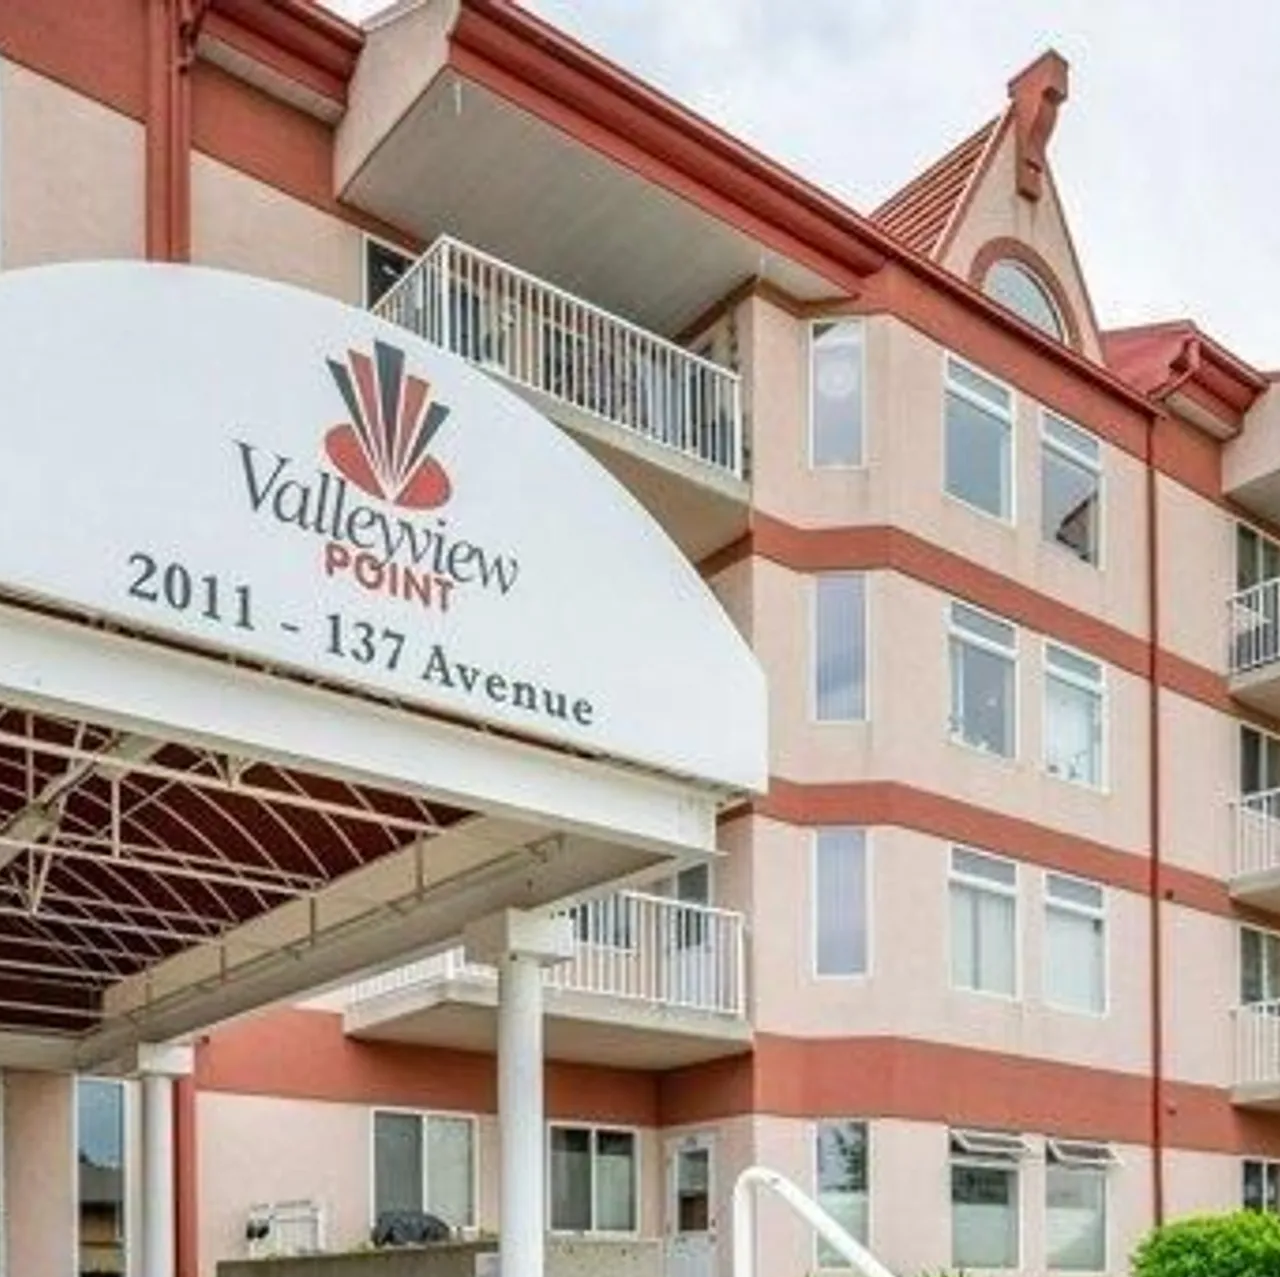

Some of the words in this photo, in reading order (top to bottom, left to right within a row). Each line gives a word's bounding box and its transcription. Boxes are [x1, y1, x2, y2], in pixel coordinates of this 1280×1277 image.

[233, 438, 520, 595] Valleyview
[324, 542, 454, 613] POINT
[127, 552, 256, 632] 2011
[325, 613, 406, 671] 137
[421, 644, 594, 726] Avenue
